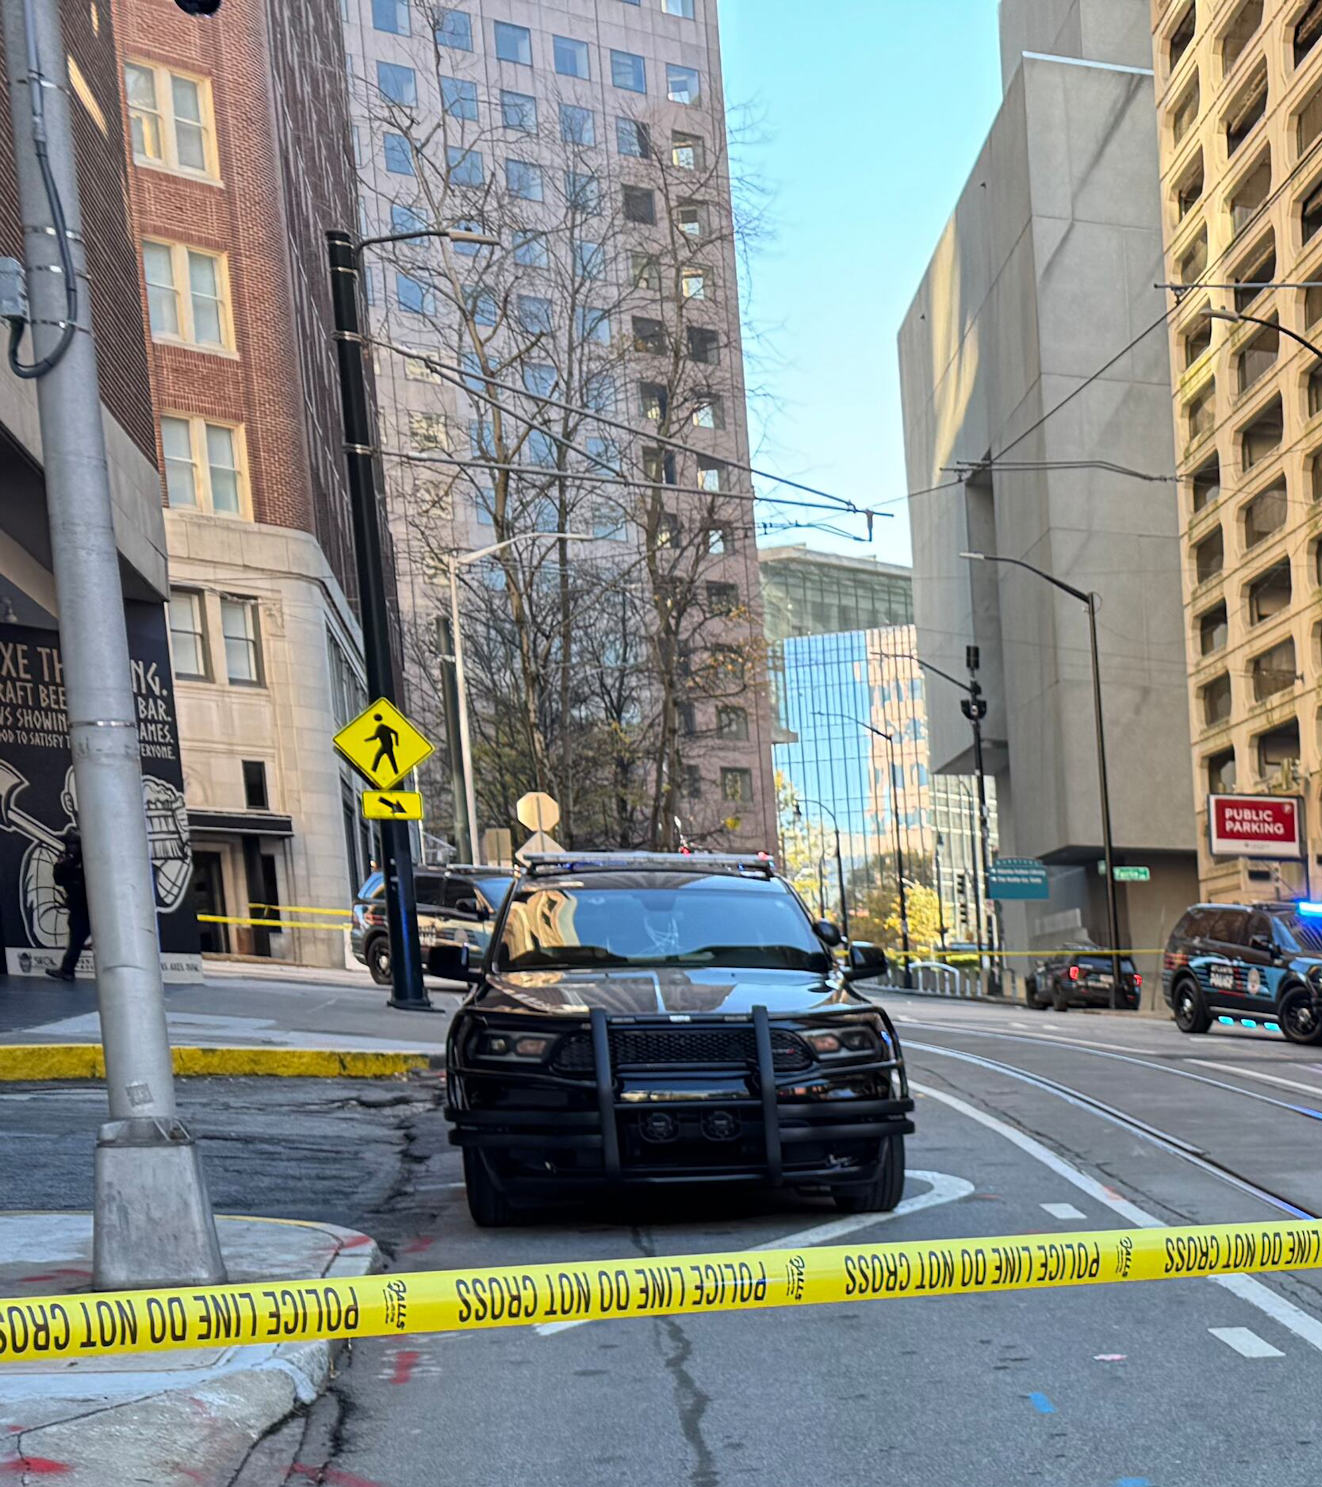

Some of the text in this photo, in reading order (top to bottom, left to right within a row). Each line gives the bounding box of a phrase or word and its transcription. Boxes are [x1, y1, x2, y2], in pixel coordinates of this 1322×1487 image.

[39, 684, 68, 710] BEE
[138, 696, 172, 721] BAR.
[16, 708, 70, 732] SHOWIN
[140, 721, 174, 744] AMES.
[16, 730, 27, 745] TO
[29, 732, 63, 749] SATISFY
[141, 743, 176, 760] ERYONE.
[1224, 808, 1273, 822] PUBLIC
[1225, 821, 1285, 835] PARKING
[1161, 1234, 1220, 1272] CROSS
[1221, 1232, 1256, 1268] NOT
[1257, 1231, 1282, 1266] DO
[1283, 1228, 1320, 1264] LINE
[843, 1241, 1100, 1294] POLICE LINE DO NOT CROSS
[263, 1284, 359, 1335] POLICE
[454, 1260, 766, 1322] POLICE LINE DO NOT CROSS
[76, 1298, 138, 1348] NOT
[146, 1295, 187, 1343] DO
[195, 1290, 257, 1340] LINE
